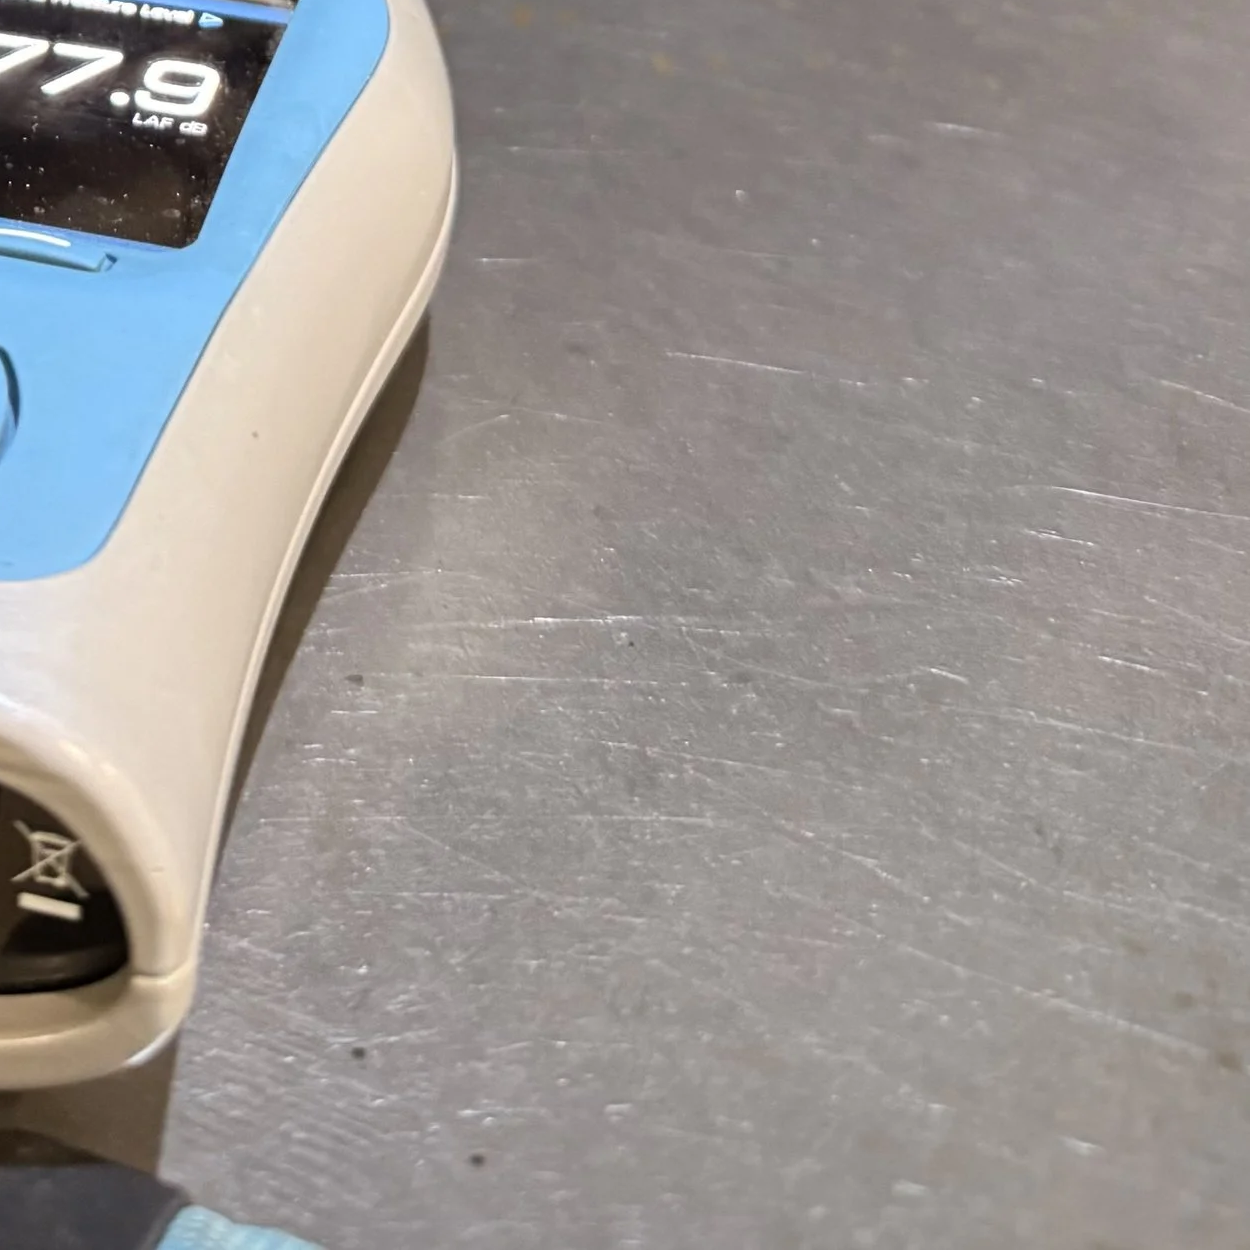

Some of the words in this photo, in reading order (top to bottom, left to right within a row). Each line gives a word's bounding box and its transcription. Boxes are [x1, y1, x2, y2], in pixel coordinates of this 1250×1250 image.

[139, 4, 195, 25] Level
[132, 112, 174, 129] LAF
[179, 120, 208, 136] dB
